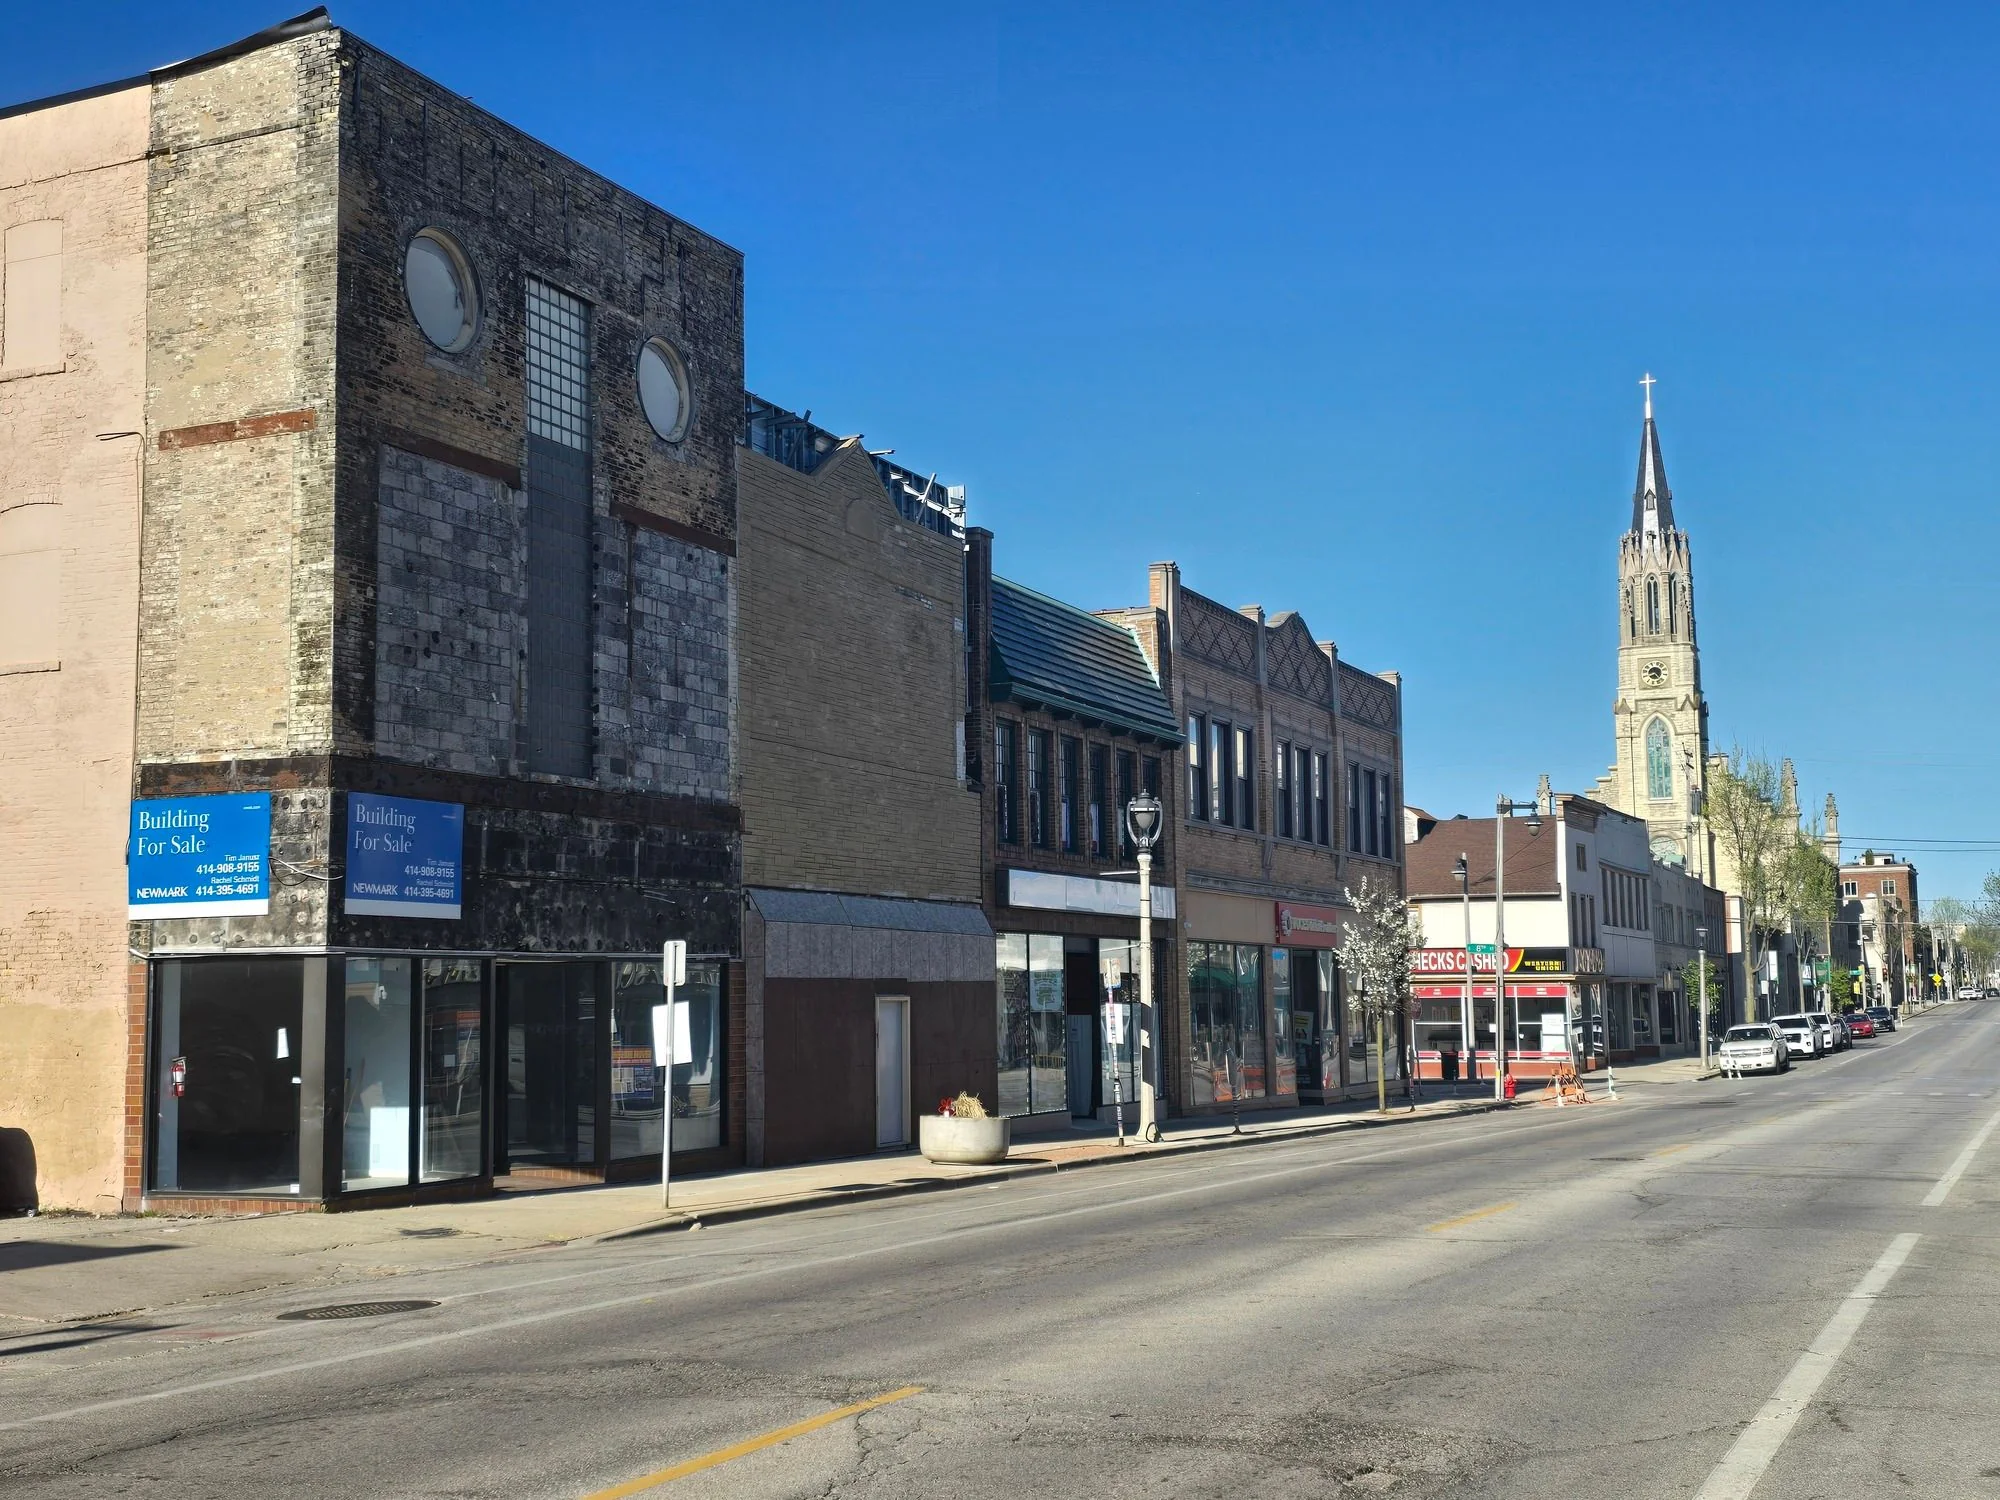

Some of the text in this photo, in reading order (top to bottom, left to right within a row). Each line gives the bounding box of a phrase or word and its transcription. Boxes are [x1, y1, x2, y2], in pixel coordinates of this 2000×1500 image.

[139, 809, 210, 833] Building
[356, 804, 416, 834] Building
[137, 834, 206, 856] For Sale
[354, 830, 412, 853] For Sale
[225, 854, 237, 862] Tim
[196, 861, 260, 874] 414-908-9155
[404, 865, 455, 878] 414-908-9155
[211, 875, 259, 884] Rachel Schmidt
[137, 886, 189, 899] NEWMARK
[195, 883, 259, 896] 414-395-4691
[353, 882, 398, 896] NEWMARK
[404, 886, 454, 899] 414-395-4691
[1412, 951, 1455, 971] HECKS
